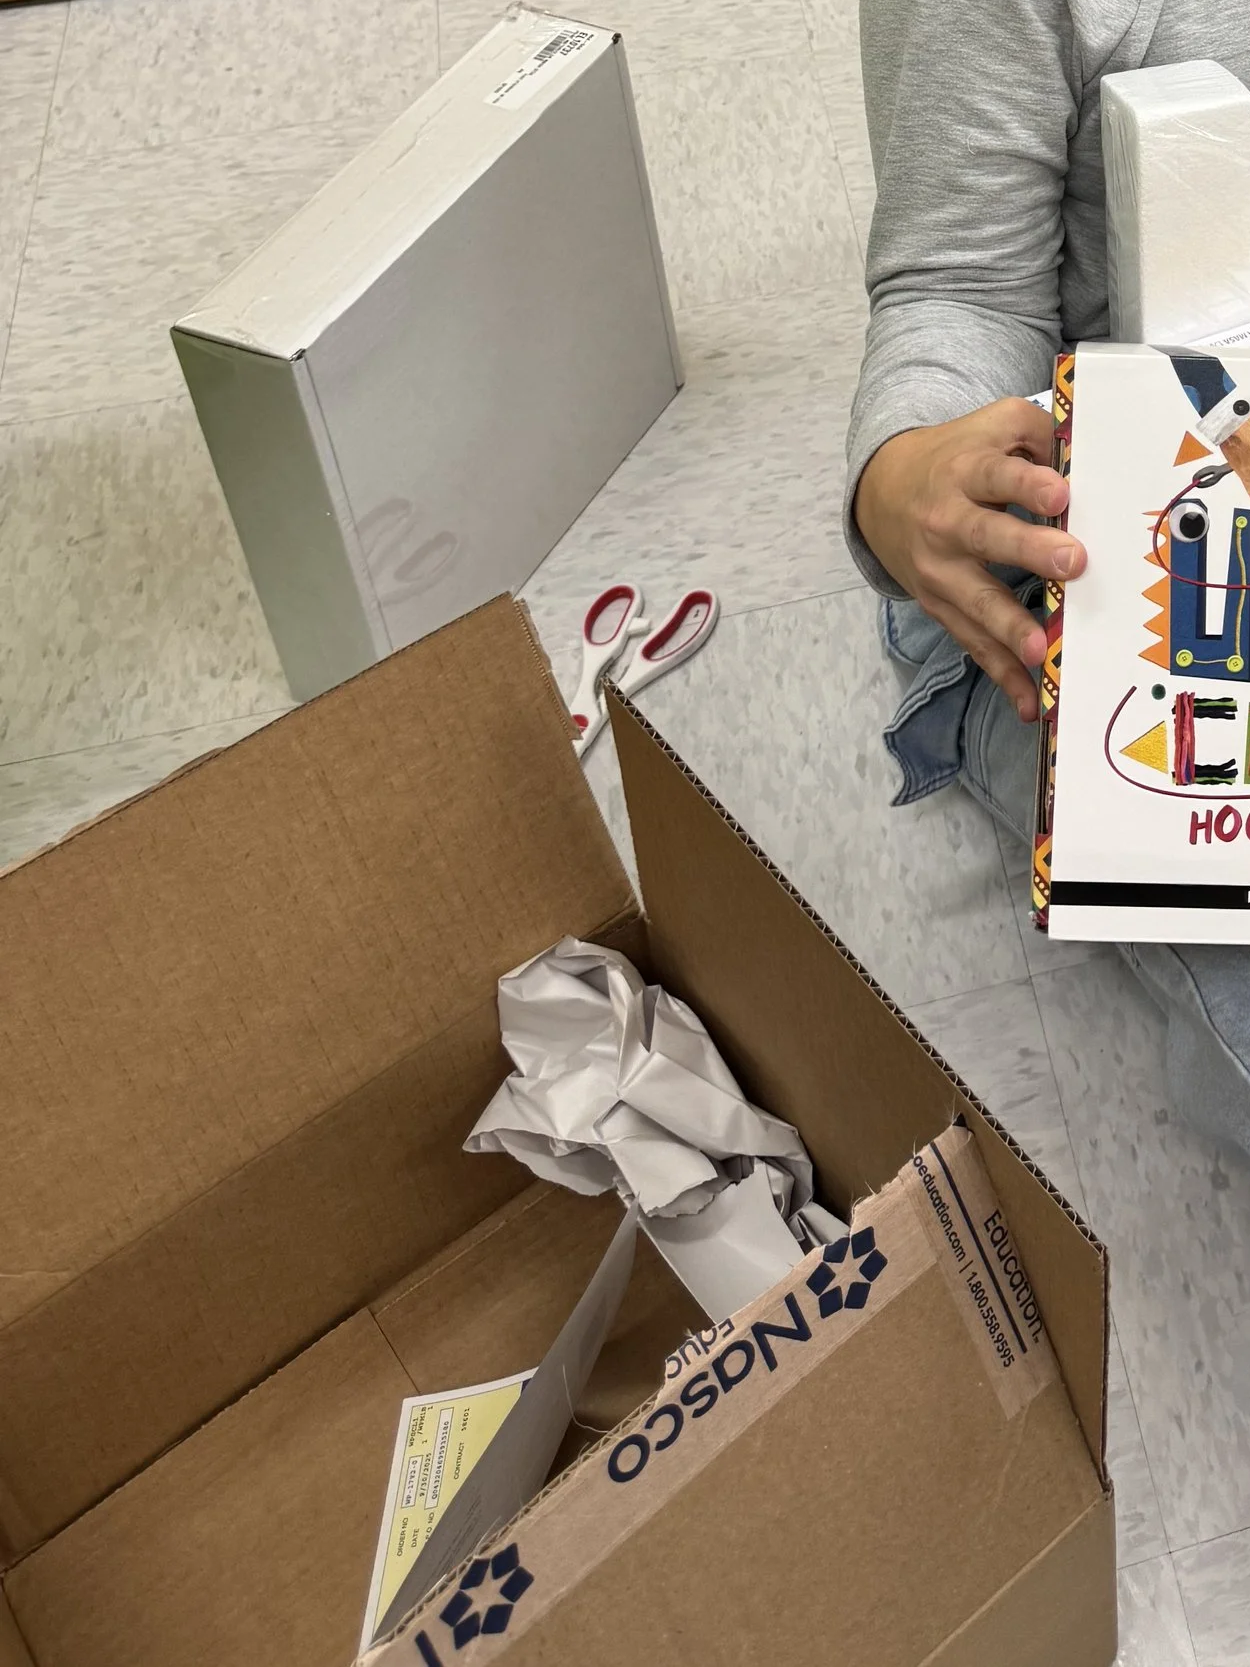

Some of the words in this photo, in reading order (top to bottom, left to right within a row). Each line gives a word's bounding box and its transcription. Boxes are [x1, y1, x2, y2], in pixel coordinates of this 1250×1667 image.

[1224, 330, 1247, 345] MASA
[983, 1209, 1044, 1339] Education
[966, 1270, 1016, 1368] 1.800.558.9595
[607, 1291, 813, 1483] Nasco
[452, 1441, 466, 1480] CONTRACT
[401, 1517, 410, 1529] NO
[411, 1527, 420, 1548] DATE
[396, 1529, 409, 1557] ORDER
